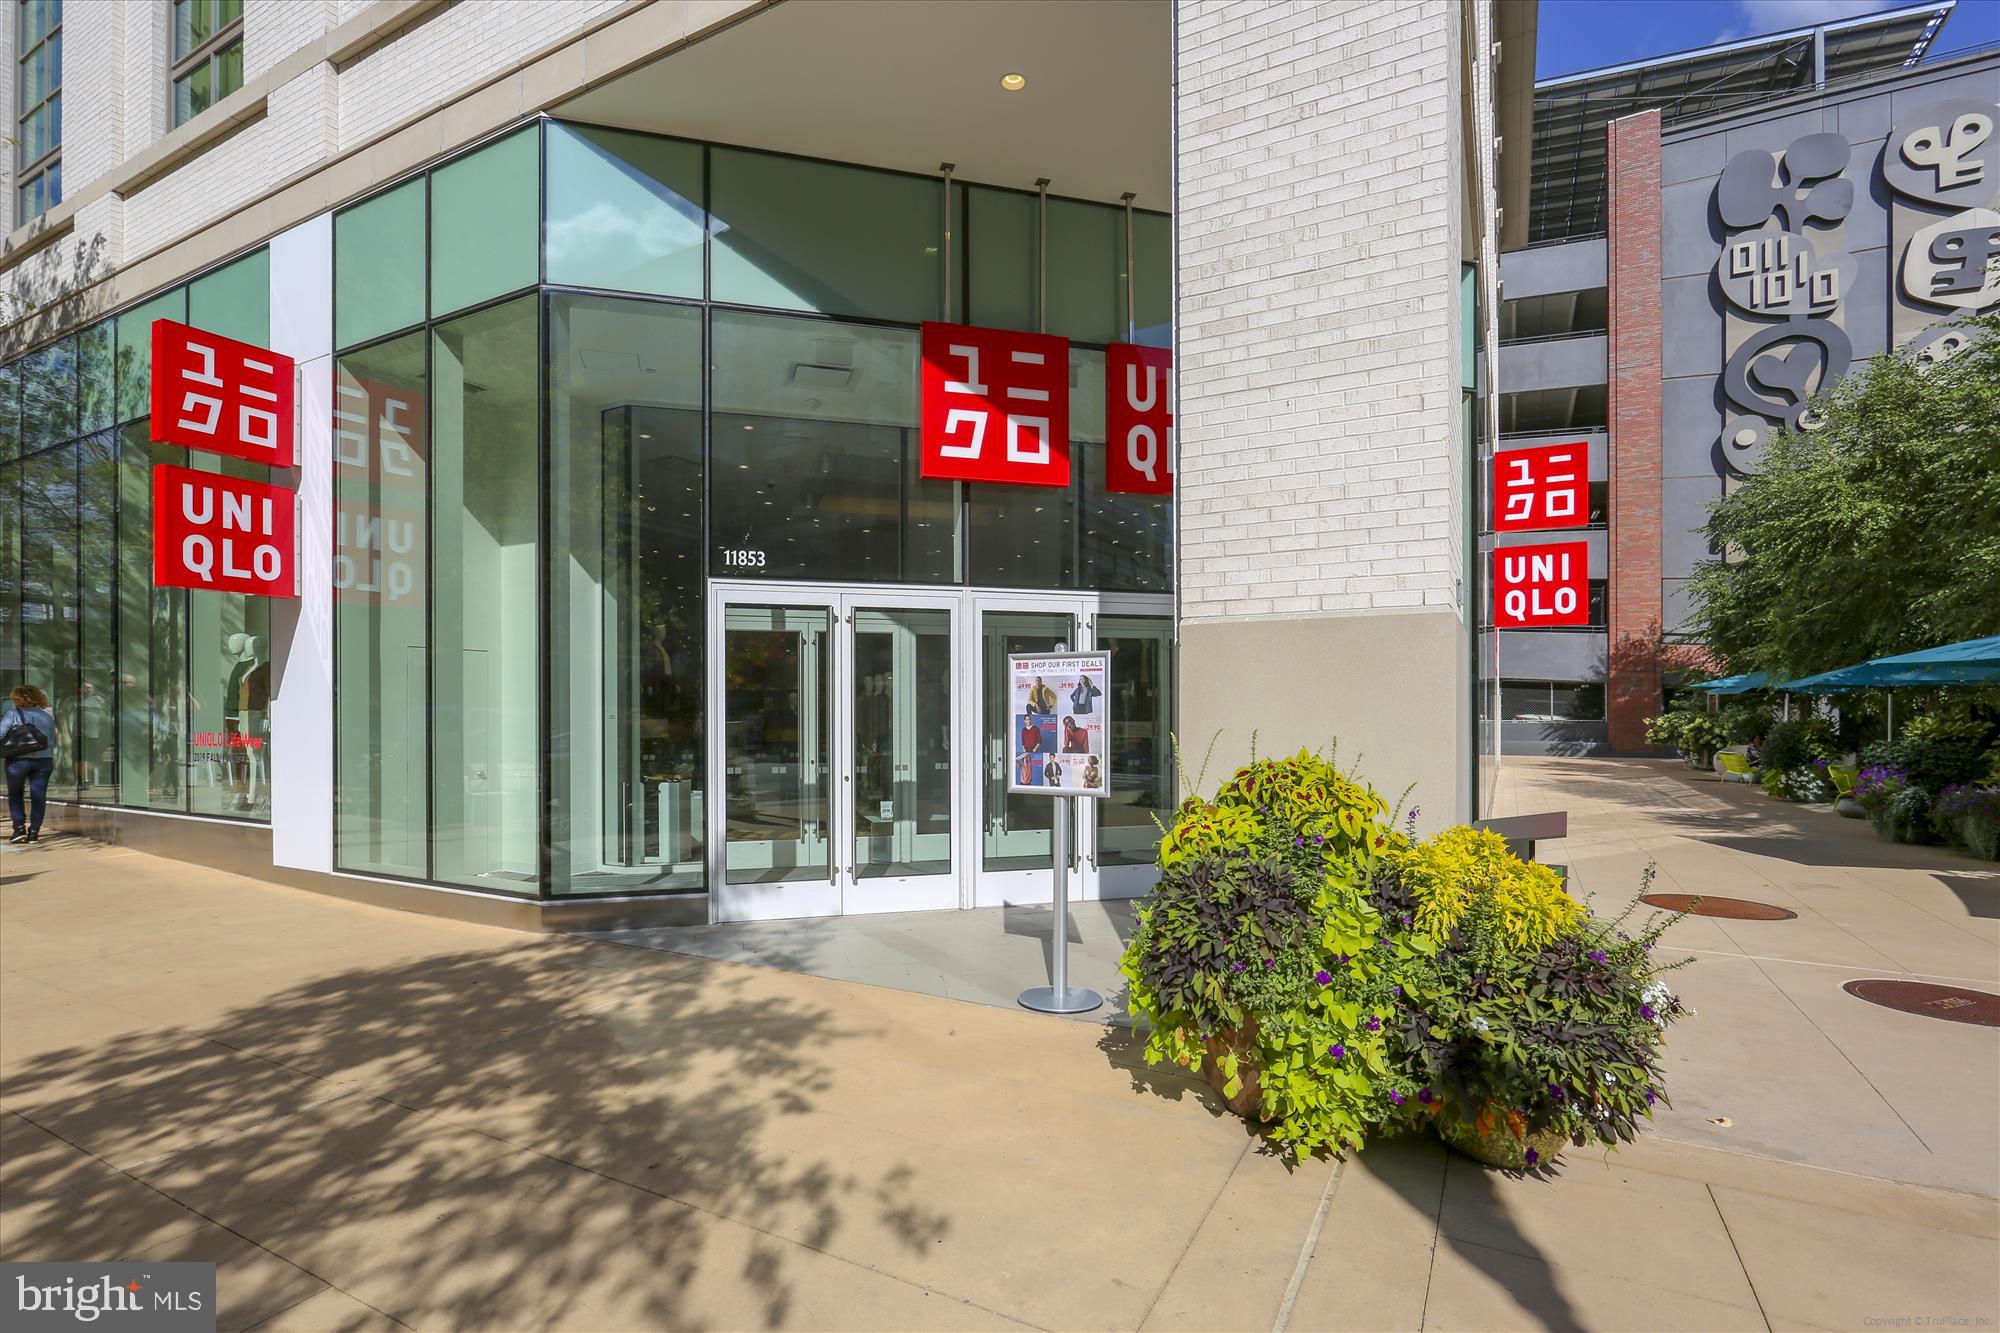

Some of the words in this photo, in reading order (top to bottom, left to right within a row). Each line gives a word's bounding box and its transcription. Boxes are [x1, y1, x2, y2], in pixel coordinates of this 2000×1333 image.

[182, 482, 273, 536] UNI
[182, 534, 282, 582] QLO
[723, 550, 766, 567] 11853
[1504, 553, 1570, 584] UNI
[1504, 587, 1577, 622] QLO
[193, 731, 223, 748] UNIQLO
